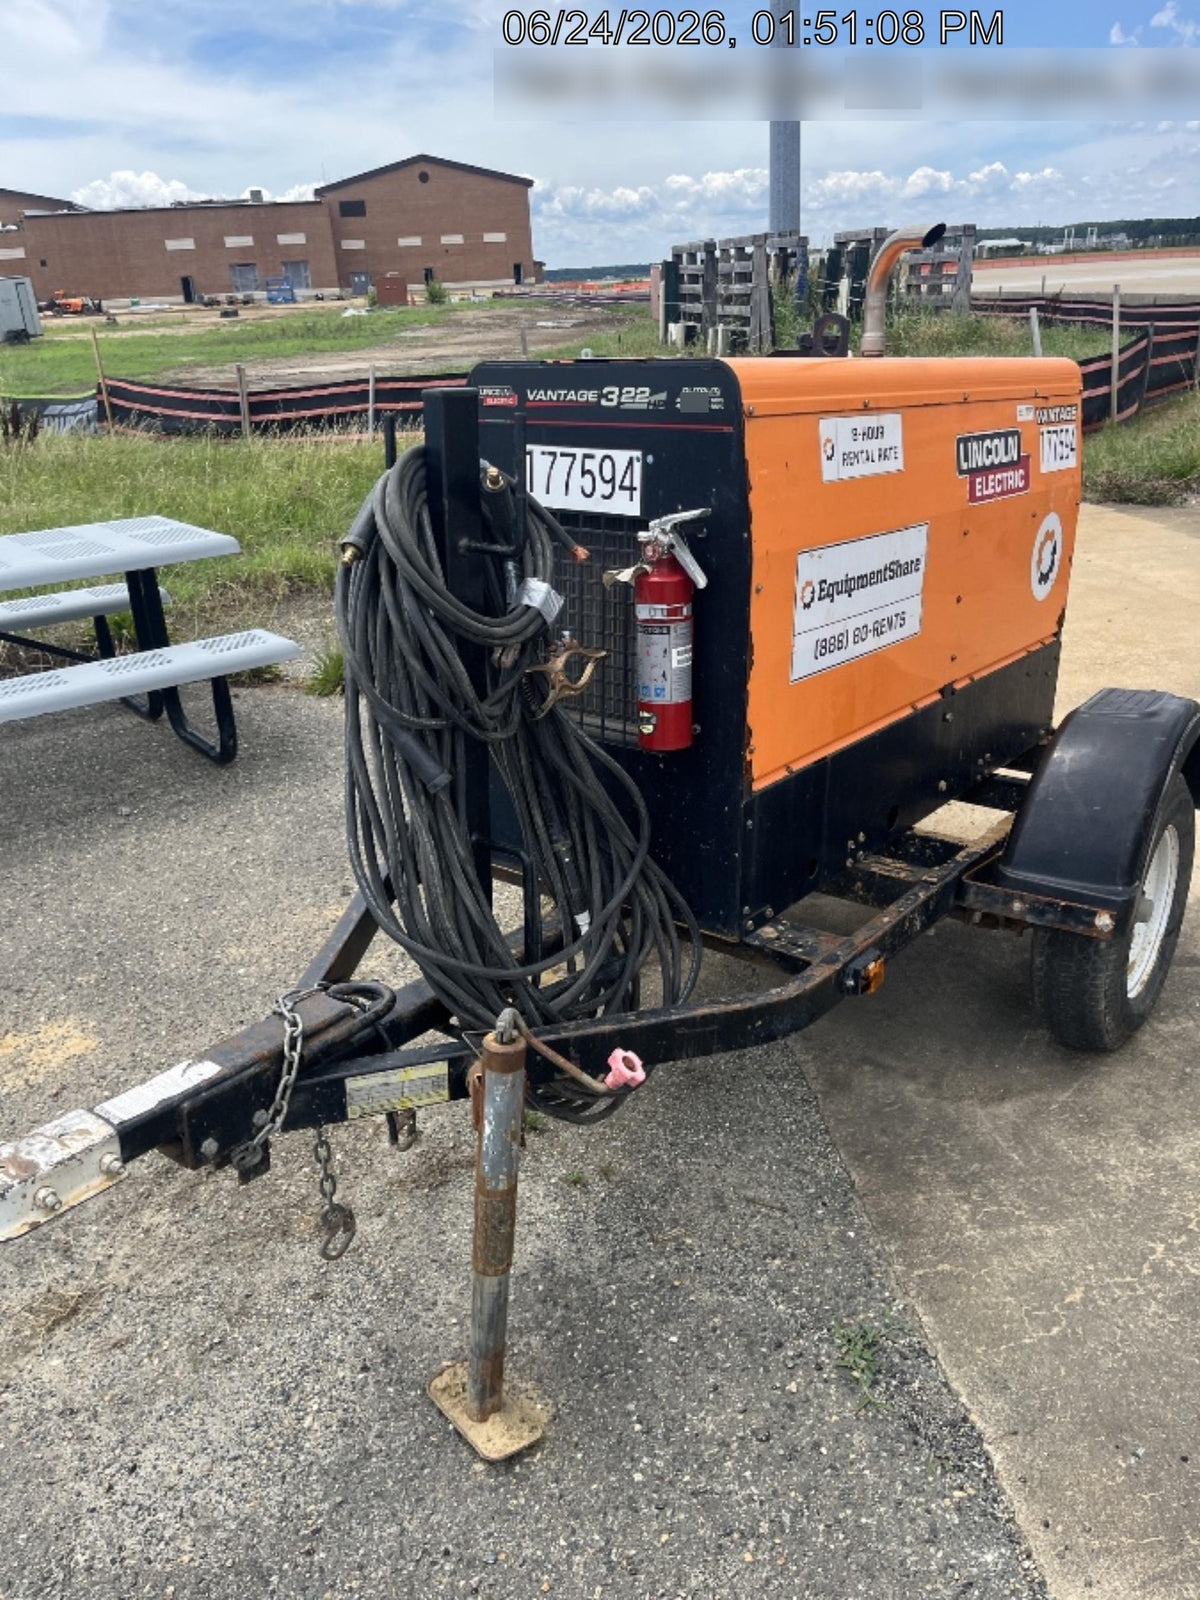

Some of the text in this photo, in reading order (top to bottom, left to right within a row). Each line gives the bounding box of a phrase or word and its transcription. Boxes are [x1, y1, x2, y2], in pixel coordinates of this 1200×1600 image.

[526, 384, 651, 407] VANTAGE 322
[842, 445, 899, 467] RENTAL RATE
[959, 435, 1018, 470] LINCOLN
[526, 451, 637, 501] 177594
[975, 468, 1025, 497] ELECTRIC
[816, 557, 922, 603] EquipmentShare
